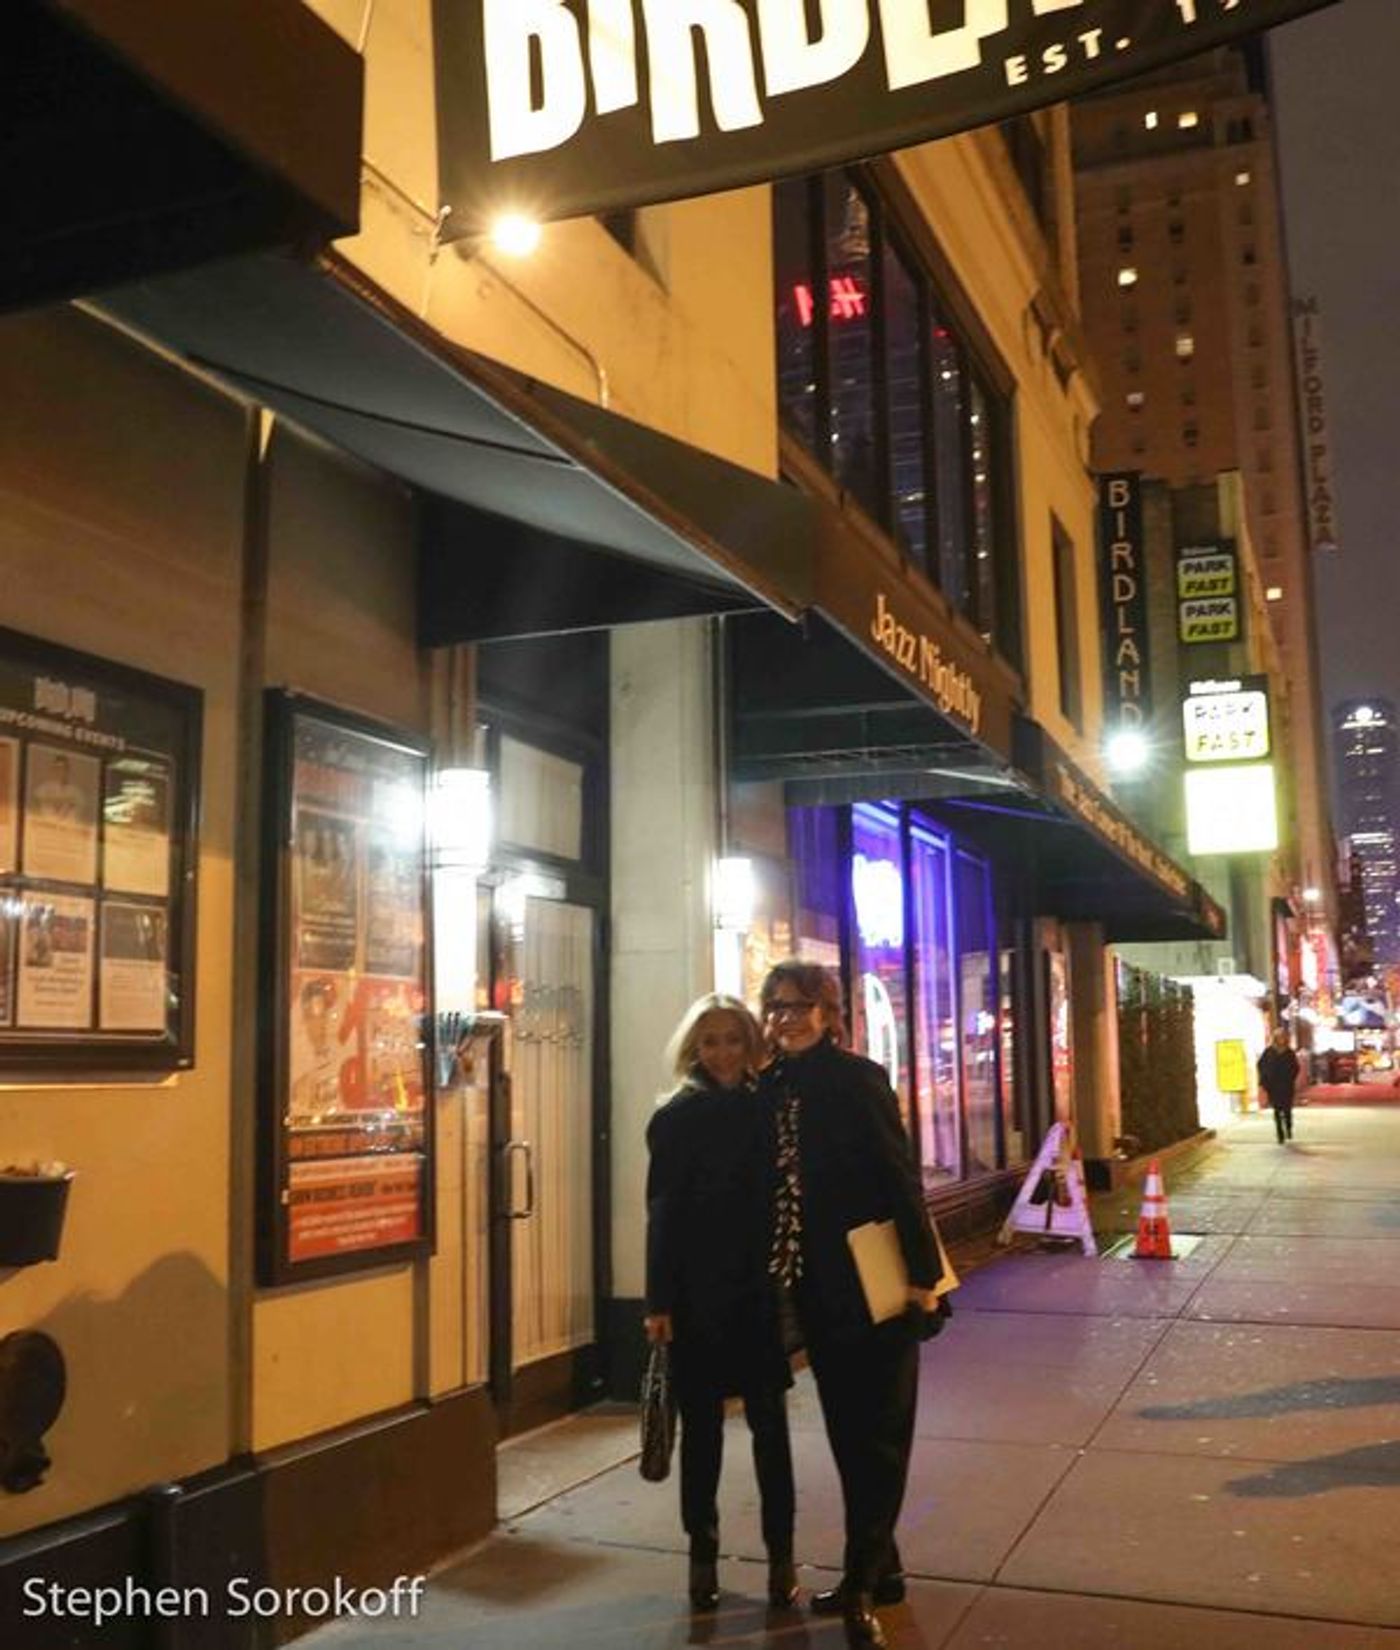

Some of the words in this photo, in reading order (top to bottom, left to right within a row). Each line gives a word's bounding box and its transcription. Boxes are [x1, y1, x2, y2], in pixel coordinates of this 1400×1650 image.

[1004, 28, 1130, 87] EST.
[1183, 560, 1230, 575] PARK
[1184, 577, 1230, 594] FAST
[1185, 602, 1232, 618] PARK
[1187, 620, 1234, 638] FAST
[870, 594, 917, 673] Jazz
[919, 634, 981, 735] Nightly
[1196, 729, 1256, 752] FAST
